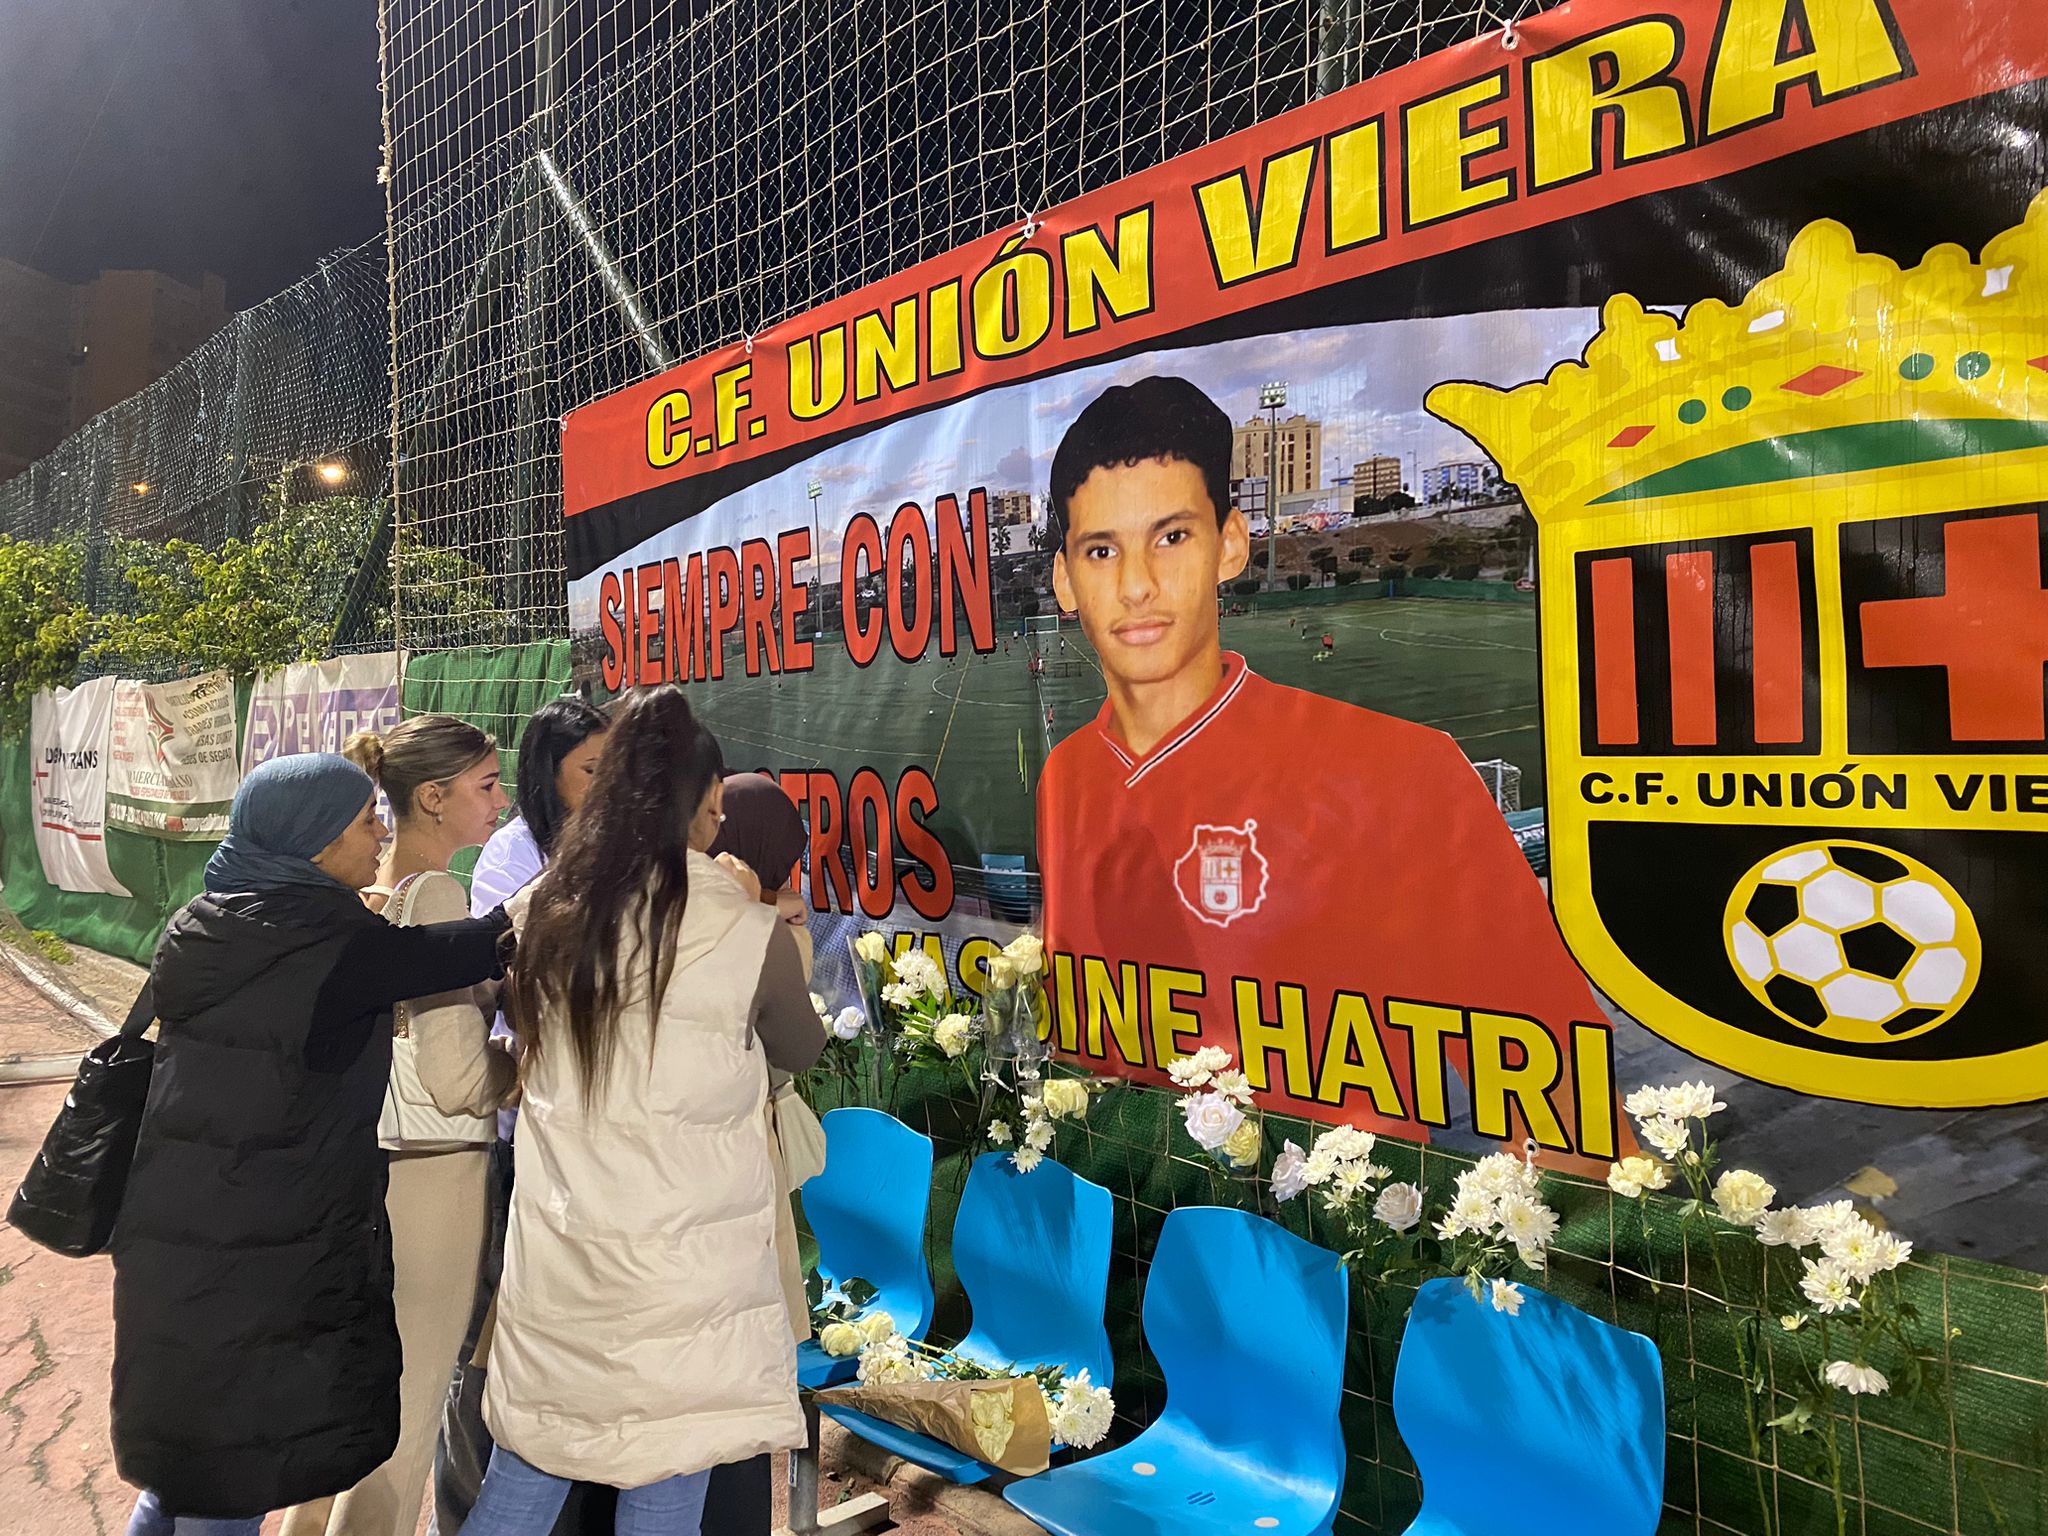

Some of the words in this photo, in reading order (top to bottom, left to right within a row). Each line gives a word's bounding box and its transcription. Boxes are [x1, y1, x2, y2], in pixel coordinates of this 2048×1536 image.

[645, 363, 768, 470] C.F.
[787, 202, 1154, 421] UNIÓN
[1192, 0, 1920, 289] VIERA
[599, 526, 815, 695] SIEMPRE
[840, 486, 998, 669] CON
[755, 765, 955, 922] TROS
[1579, 772, 1679, 806] C.F.
[1697, 763, 1907, 810] UNIÓN
[1935, 773, 2048, 813] VIE
[1231, 974, 1624, 1163] HATRI
